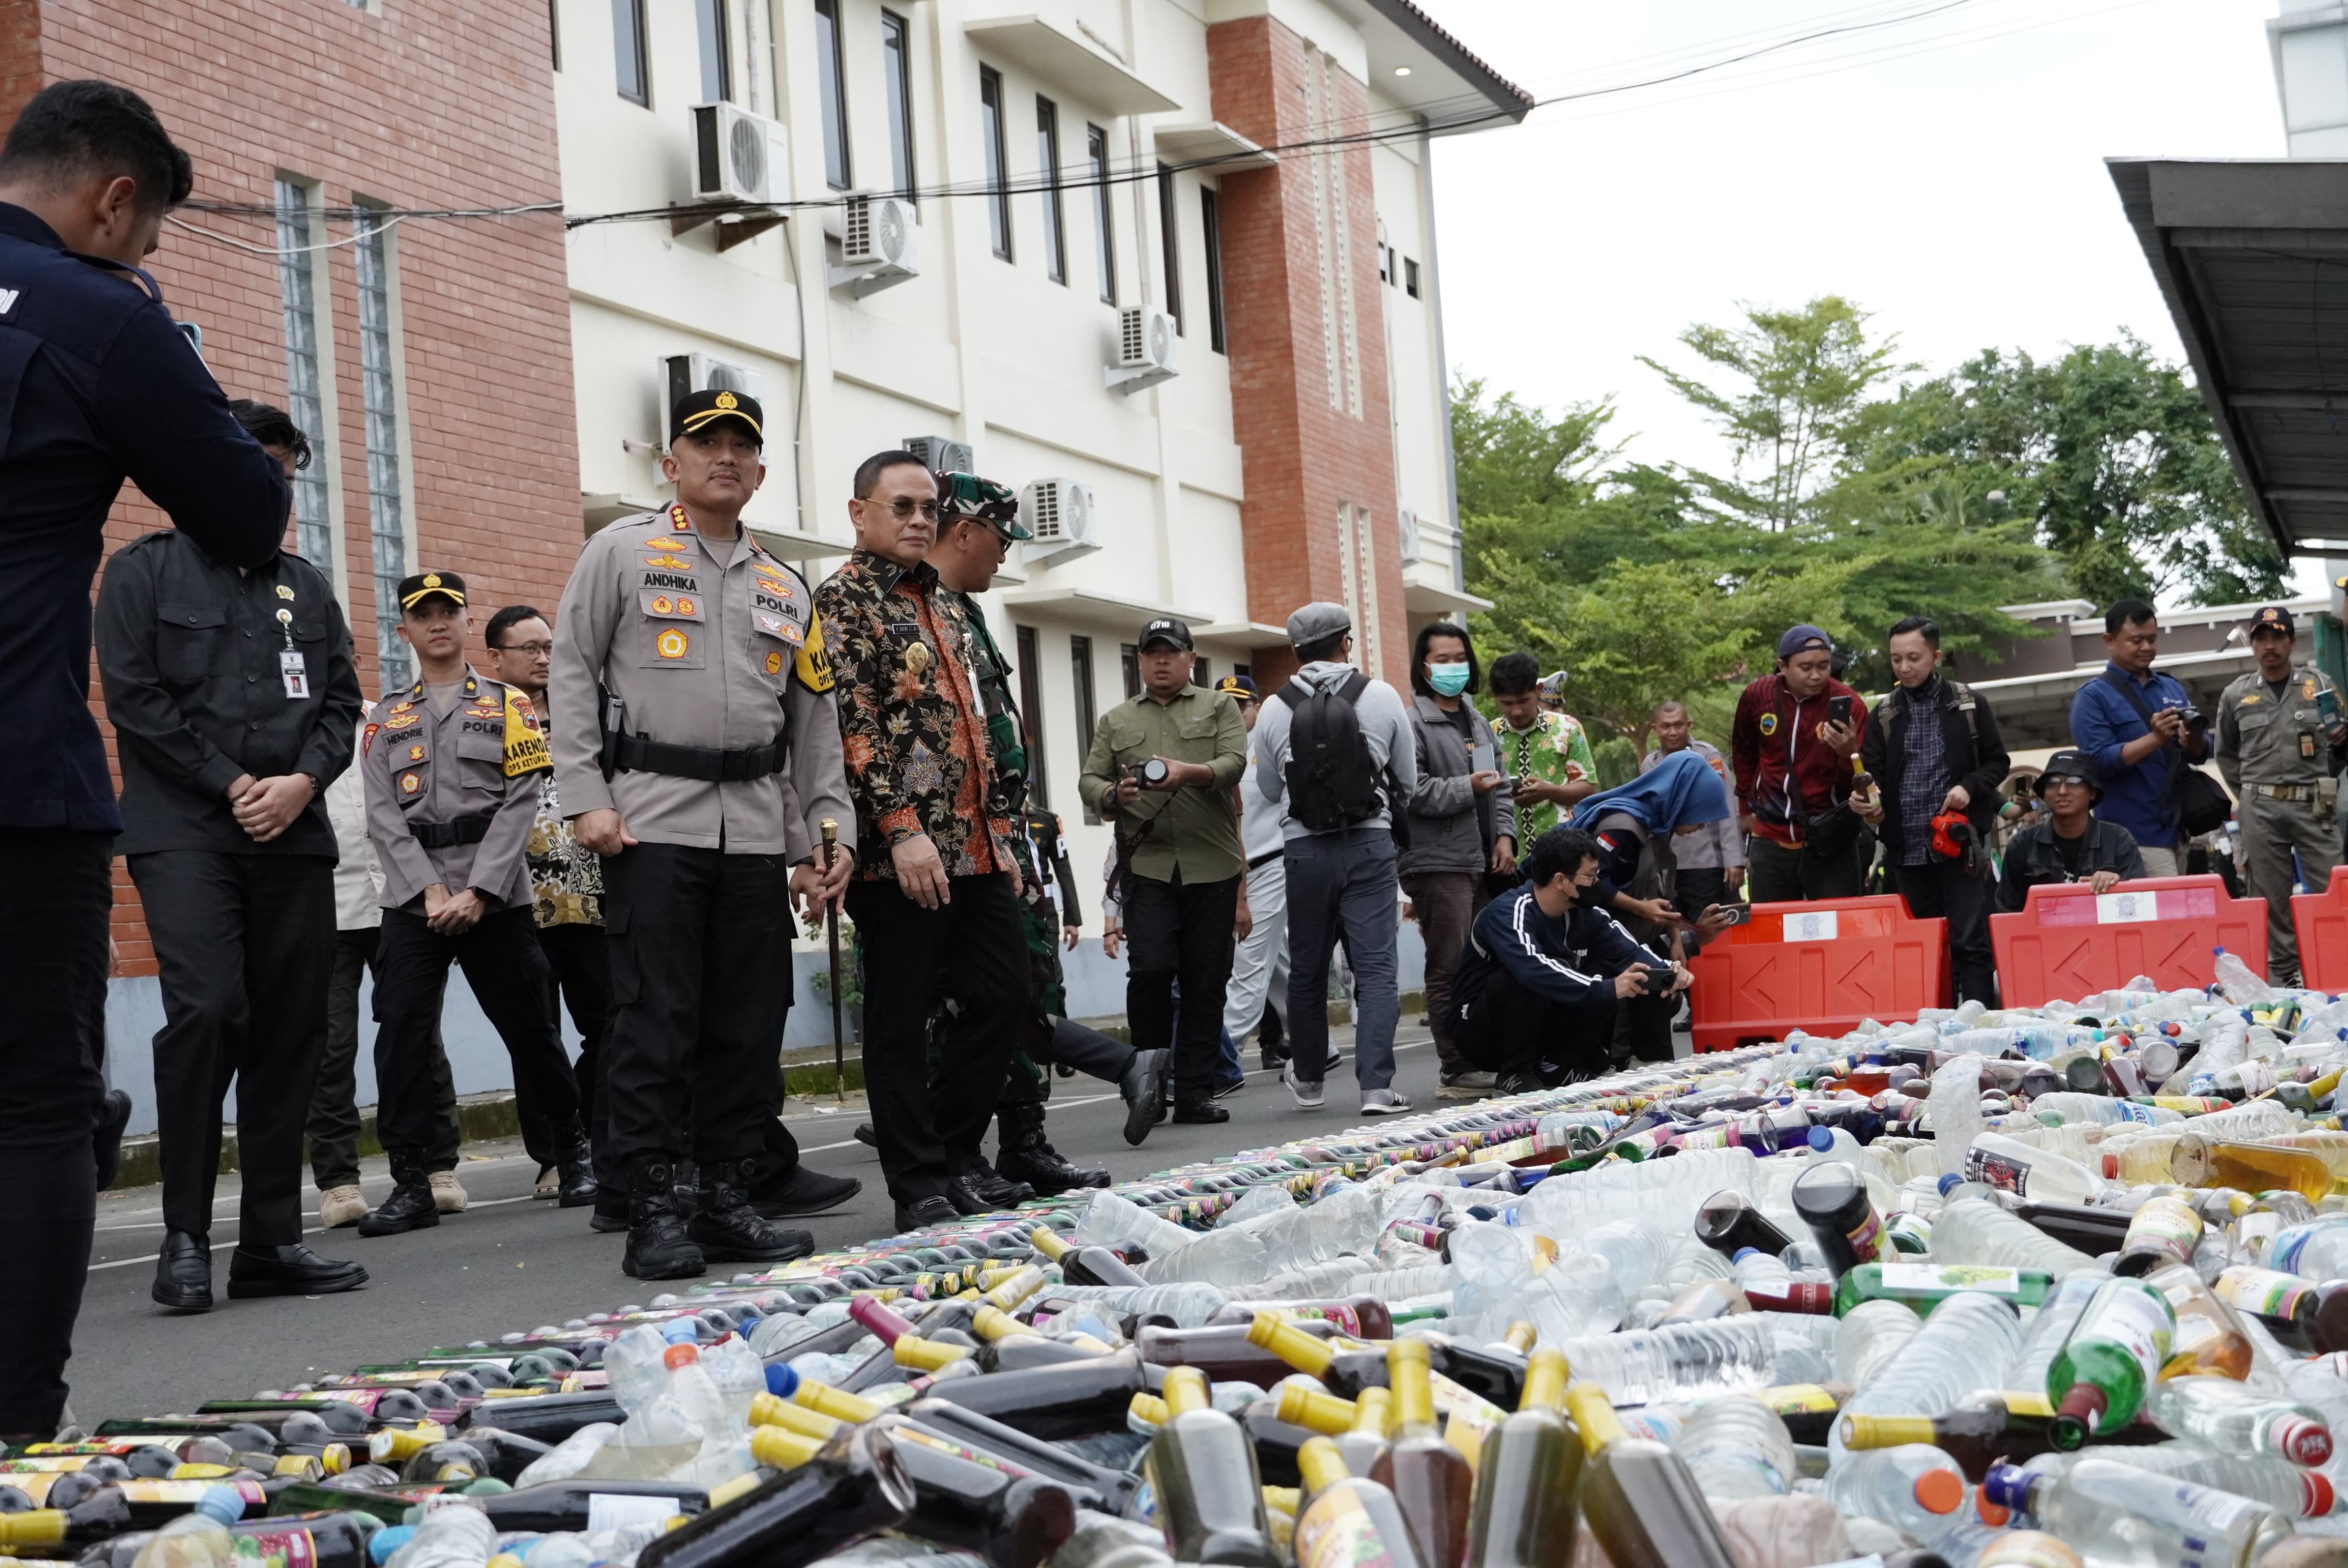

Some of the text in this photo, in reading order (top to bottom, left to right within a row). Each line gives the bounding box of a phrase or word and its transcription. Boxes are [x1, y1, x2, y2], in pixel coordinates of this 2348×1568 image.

[644, 572, 697, 592] ANDHIKA
[756, 594, 798, 619] POLRI
[1150, 620, 1170, 630] 0718
[387, 727, 423, 746] HENDRIE
[463, 721, 503, 736] POLRI
[509, 763, 520, 773] OPS
[523, 755, 547, 768] KETUPAT
